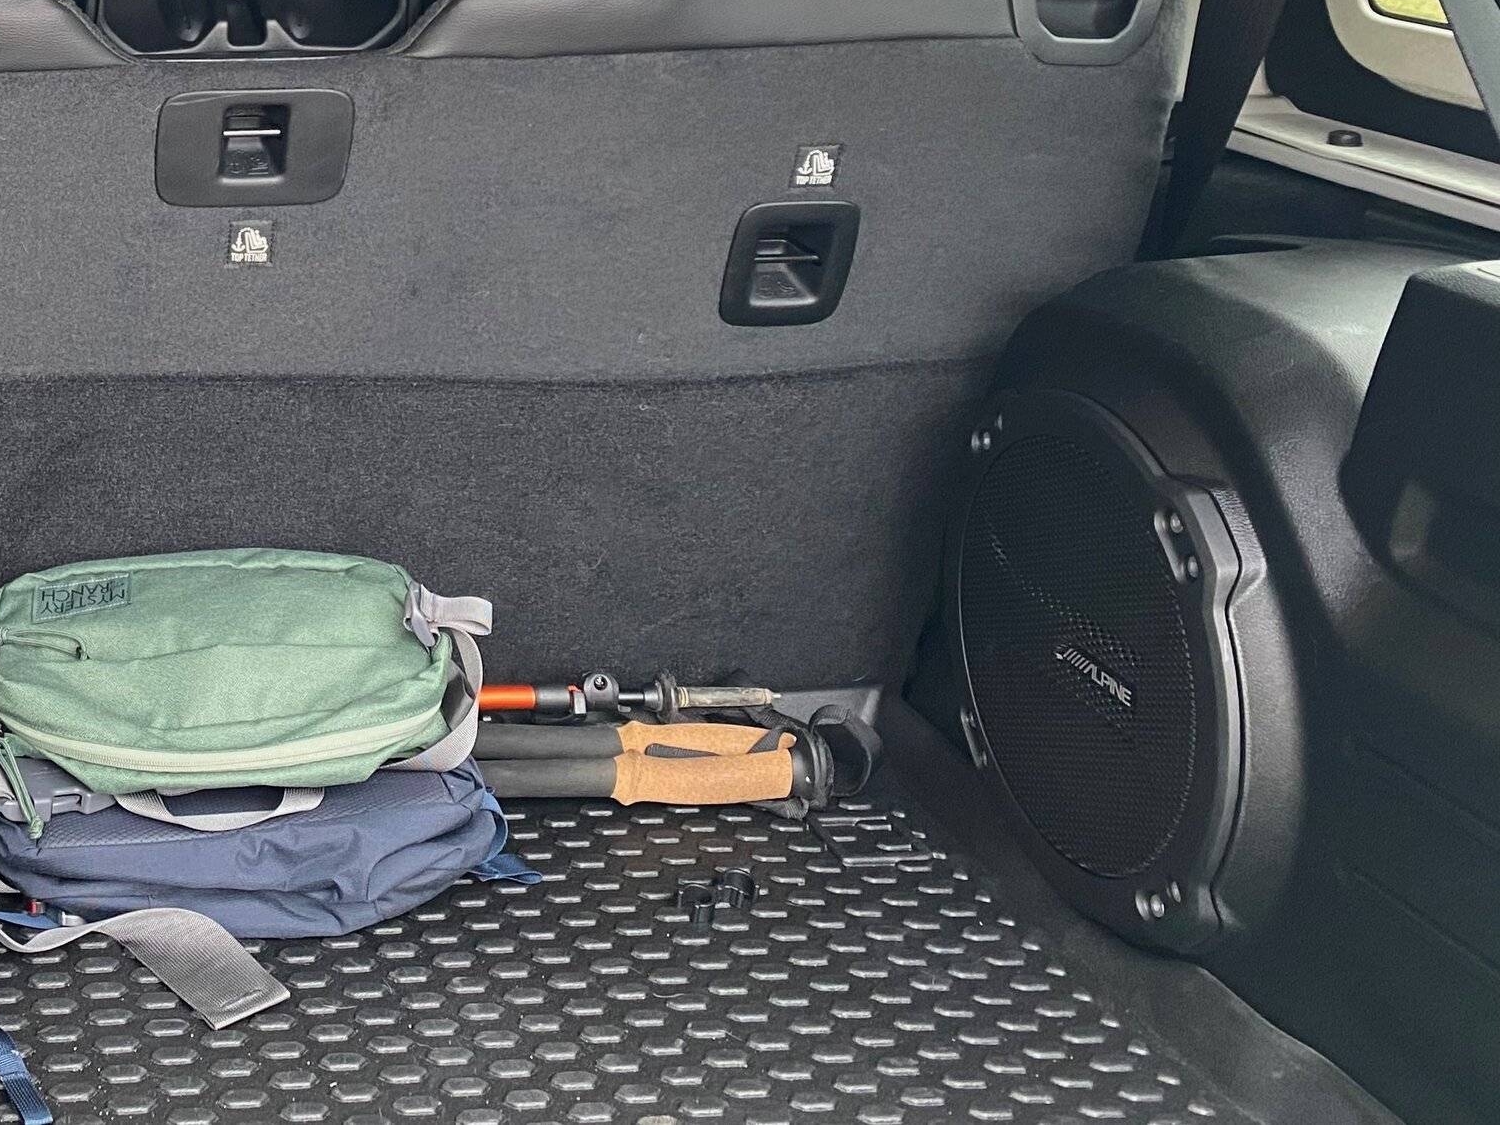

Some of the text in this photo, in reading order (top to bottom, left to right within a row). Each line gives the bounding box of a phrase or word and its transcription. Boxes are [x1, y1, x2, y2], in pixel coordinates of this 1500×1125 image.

[230, 252, 268, 263] TOP TETHER
[40, 588, 125, 614] MYSTERY
[41, 582, 111, 602] RANCH
[1083, 663, 1132, 707] ALPINE
